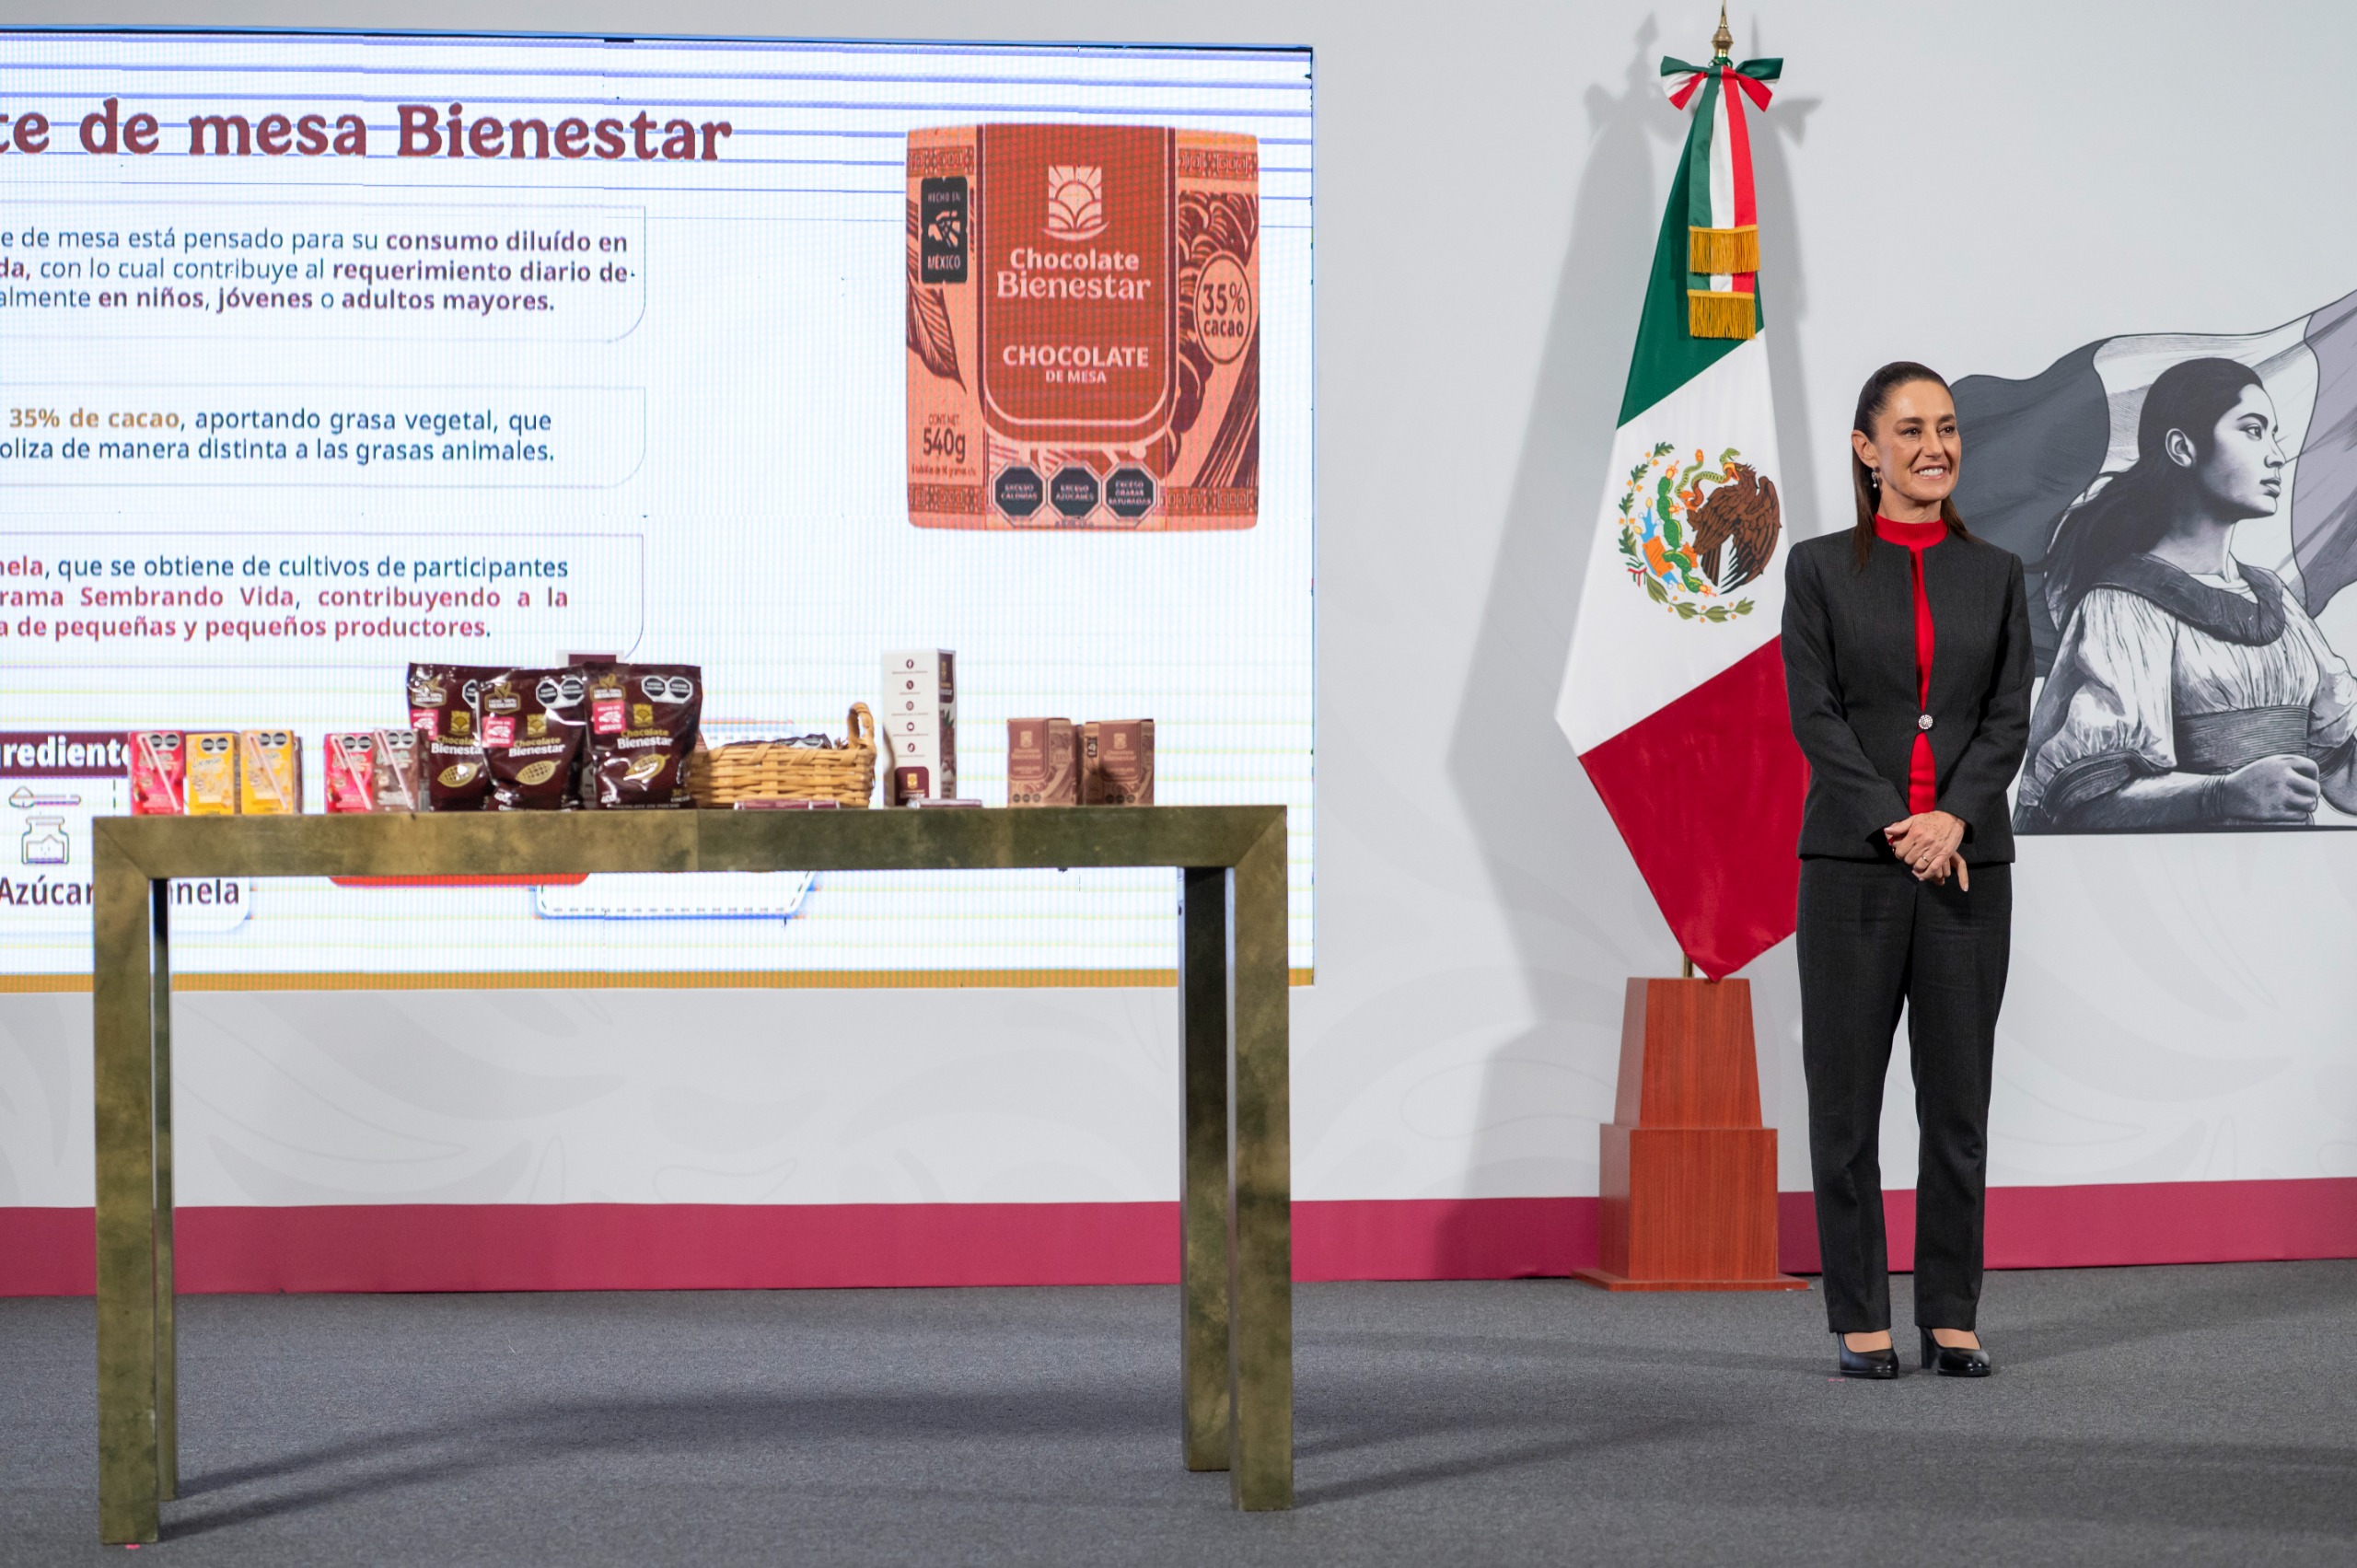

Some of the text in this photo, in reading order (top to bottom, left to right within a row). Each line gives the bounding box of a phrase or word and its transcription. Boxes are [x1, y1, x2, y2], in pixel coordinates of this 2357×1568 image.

[79, 97, 159, 155] de
[189, 113, 366, 157] mesa
[397, 102, 733, 161] Bienestar
[21, 226, 50, 249] de
[59, 230, 120, 249] mesa
[129, 226, 175, 249] está
[184, 226, 284, 254] pensado
[292, 232, 343, 254] para
[352, 233, 378, 250] su
[386, 233, 499, 251] consumo
[505, 230, 591, 252] diluído
[598, 236, 628, 252] en
[41, 261, 81, 278] con
[90, 258, 110, 278] lo
[118, 258, 165, 278] cual
[172, 259, 297, 285] contribuye
[305, 259, 324, 279] al
[332, 260, 512, 285] requerimiento
[520, 261, 591, 282] diario
[598, 261, 628, 283] de
[928, 254, 961, 270] MÉXICO
[1010, 248, 1140, 271] Chocolate
[997, 271, 1152, 300] Bienestar
[1202, 282, 1246, 316] 35%
[99, 293, 127, 308] en
[136, 286, 210, 311] niños,
[216, 286, 313, 314] jóvenes
[321, 293, 334, 309] o
[342, 289, 435, 310] adultos
[443, 294, 554, 316] mayores.
[1203, 319, 1244, 338] cacao
[1003, 345, 1150, 367] CHOCOLATE
[1045, 370, 1108, 384] DE MESA
[9, 407, 552, 436] 35% de cacao, aportando grasa vegetal, que
[62, 437, 90, 459] de
[99, 442, 190, 459] manera
[198, 437, 287, 459] distinta
[296, 443, 308, 459] a
[318, 438, 348, 459] las
[356, 443, 435, 466] grasas
[442, 439, 554, 462] animales.
[923, 427, 966, 464] 540g
[58, 559, 102, 582] que
[110, 559, 135, 576] se
[144, 555, 234, 576] obtiene
[242, 555, 271, 576] de
[279, 555, 370, 576] cultivos
[377, 556, 406, 577] de
[413, 557, 569, 583] participantes
[80, 587, 224, 608] Sembrando
[240, 587, 301, 610] Vida,
[319, 587, 501, 613] contribuyendo
[517, 592, 530, 608] a
[548, 587, 568, 608] la
[17, 616, 47, 637] de
[55, 616, 176, 642] pequeñas
[183, 621, 198, 642] y
[205, 616, 327, 642] pequeños
[335, 618, 491, 642] productores.
[0, 735, 130, 767] redient
[431, 742, 483, 755] Bienesta
[508, 744, 565, 758] Bienestar
[617, 736, 674, 749] Bienestar
[169, 878, 239, 905] nela
